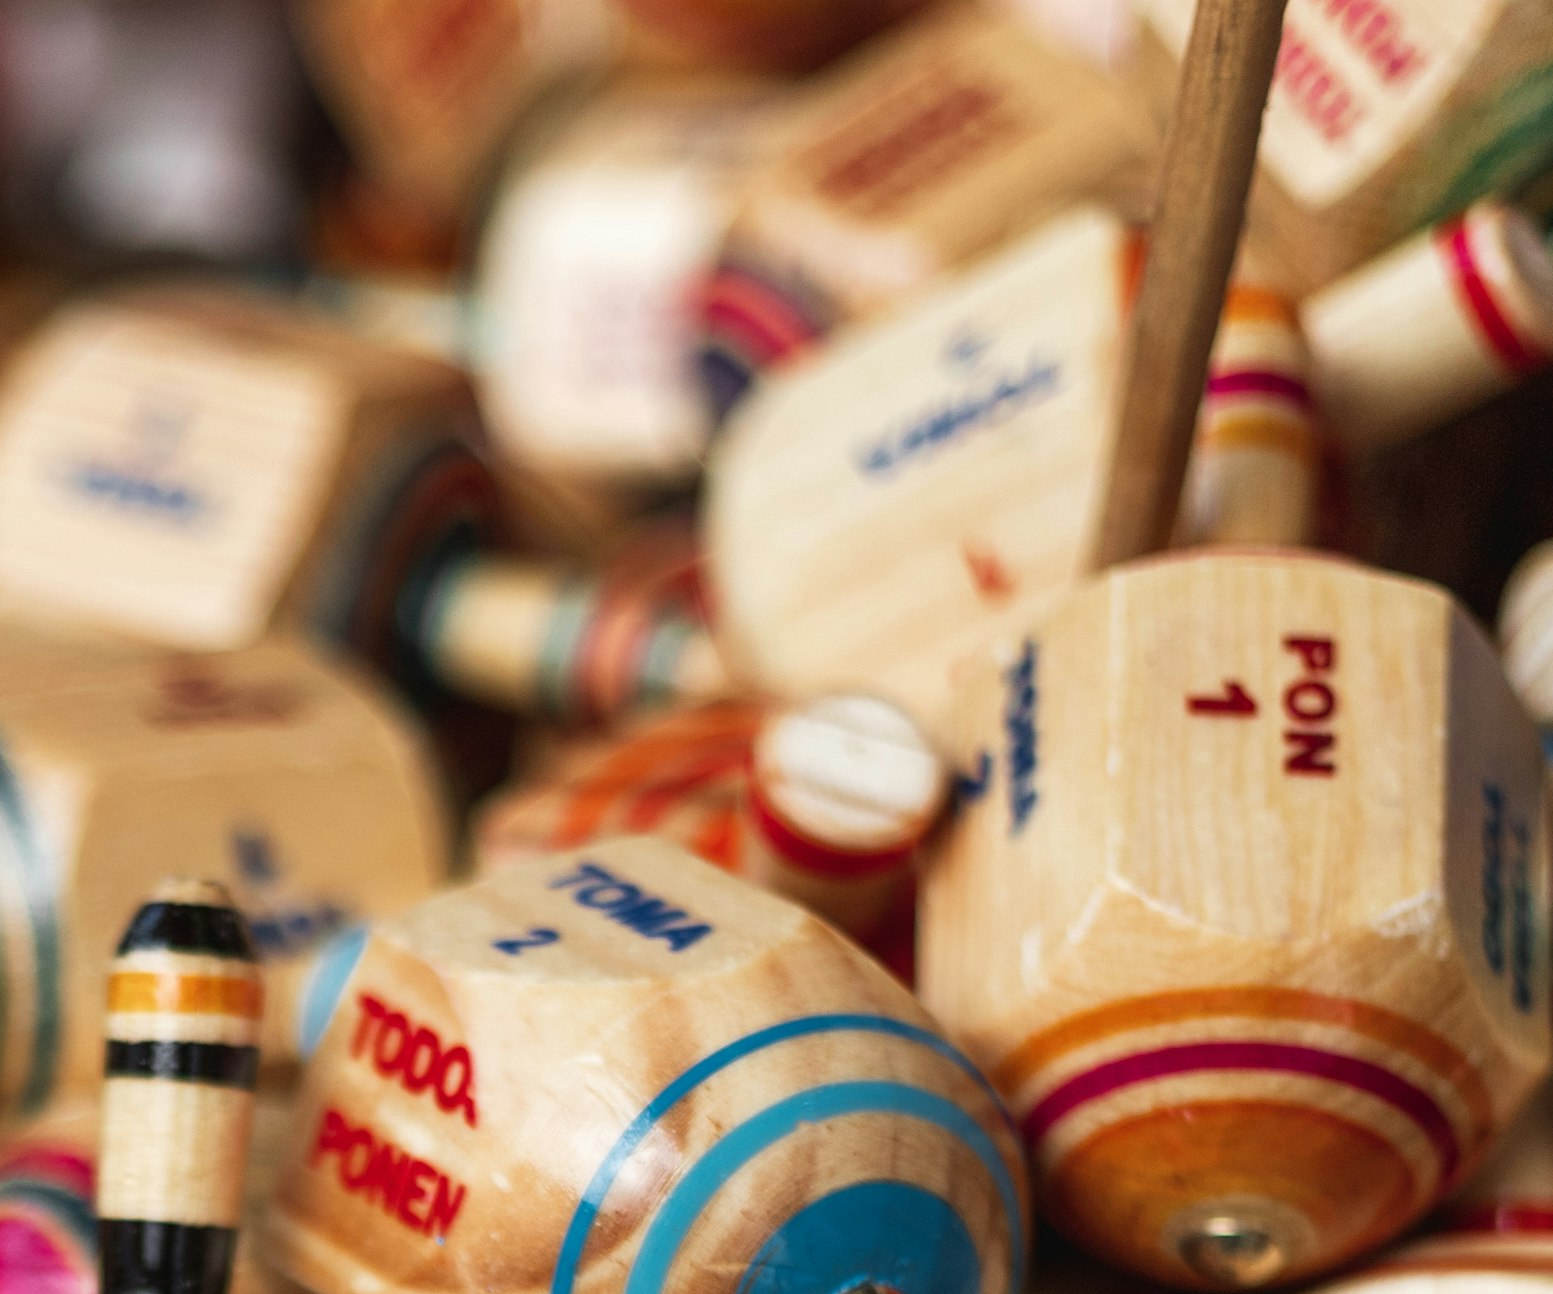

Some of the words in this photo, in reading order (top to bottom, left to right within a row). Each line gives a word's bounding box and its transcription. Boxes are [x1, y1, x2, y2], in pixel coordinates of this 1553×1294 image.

[1185, 678, 1258, 720] 1
[1282, 633, 1337, 778] PON
[493, 928, 562, 956] 2
[550, 864, 712, 953] TOMA
[309, 1107, 467, 1238] PONEN
